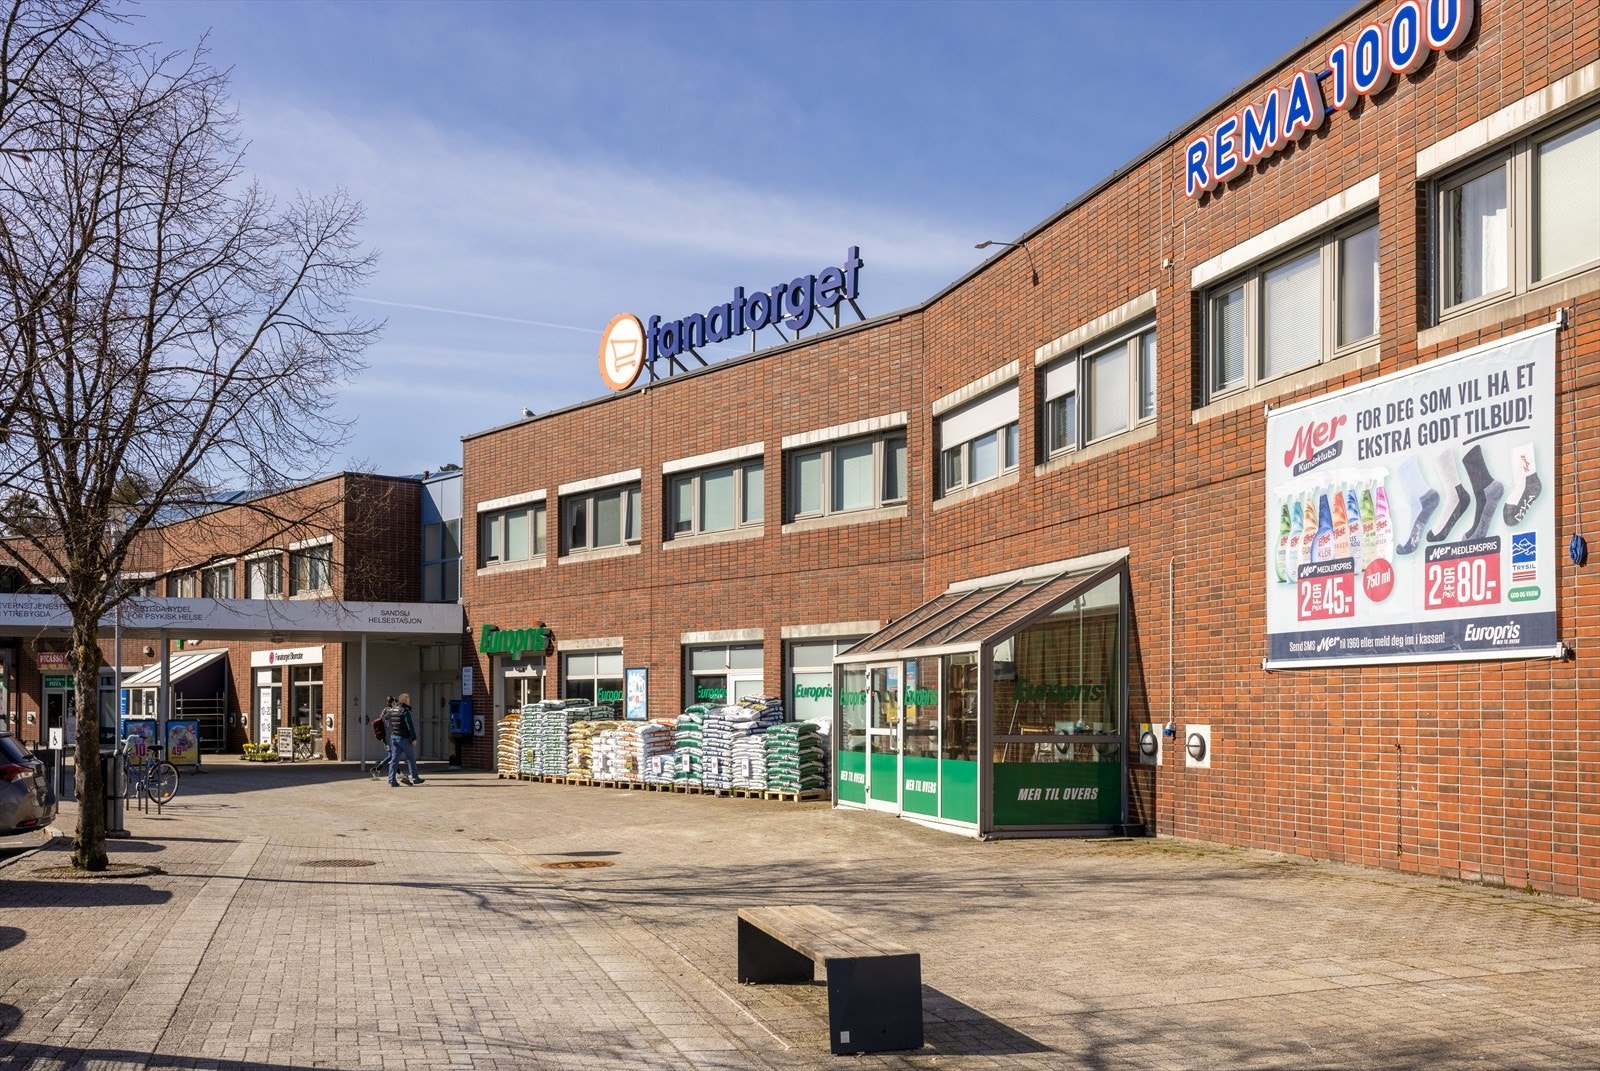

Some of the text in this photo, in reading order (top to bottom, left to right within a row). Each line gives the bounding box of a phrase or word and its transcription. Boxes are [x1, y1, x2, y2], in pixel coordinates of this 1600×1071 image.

[1185, 0, 1461, 199] REMA 1000
[647, 246, 864, 362] fanatorget
[1356, 362, 1536, 433] FOR DEG SOM VIL HA ET
[1357, 395, 1533, 461] EKSTRA GODT TILBUD!
[1284, 414, 1347, 468] Mer
[1298, 447, 1338, 474] Kundeklubb
[1430, 541, 1498, 560] Mer MEDLEMSPRIS
[1300, 561, 1353, 578] Mer MEDLEMSPRIS
[1512, 563, 1536, 571] TRYSIL
[1366, 568, 1391, 590] 750 ml
[1429, 559, 1497, 606] 2 FOR 80.-
[1301, 577, 1352, 617] 2 FOR 45.-
[3, 610, 51, 618] YTREBYGDA
[167, 605, 192, 613] BYDEL
[178, 613, 203, 621] HELSE
[480, 620, 548, 660] Europris
[1289, 641, 1303, 652] Send
[1303, 640, 1315, 652] SMS
[1317, 636, 1340, 653] Mer
[1347, 638, 1360, 649] 1960
[1360, 637, 1374, 648] eller
[1374, 635, 1390, 647] meld
[1391, 635, 1404, 648] deg
[1404, 634, 1414, 645] inn
[1419, 632, 1446, 644] kassen!
[1464, 620, 1520, 646] Europris
[40, 654, 64, 663] PICASSO
[1013, 674, 1103, 709] Europris
[840, 770, 848, 781] MER
[853, 773, 865, 784] OVERS
[905, 779, 915, 791] MER
[922, 781, 937, 794] OVERS
[1017, 787, 1098, 801] MER TIL OVERS
